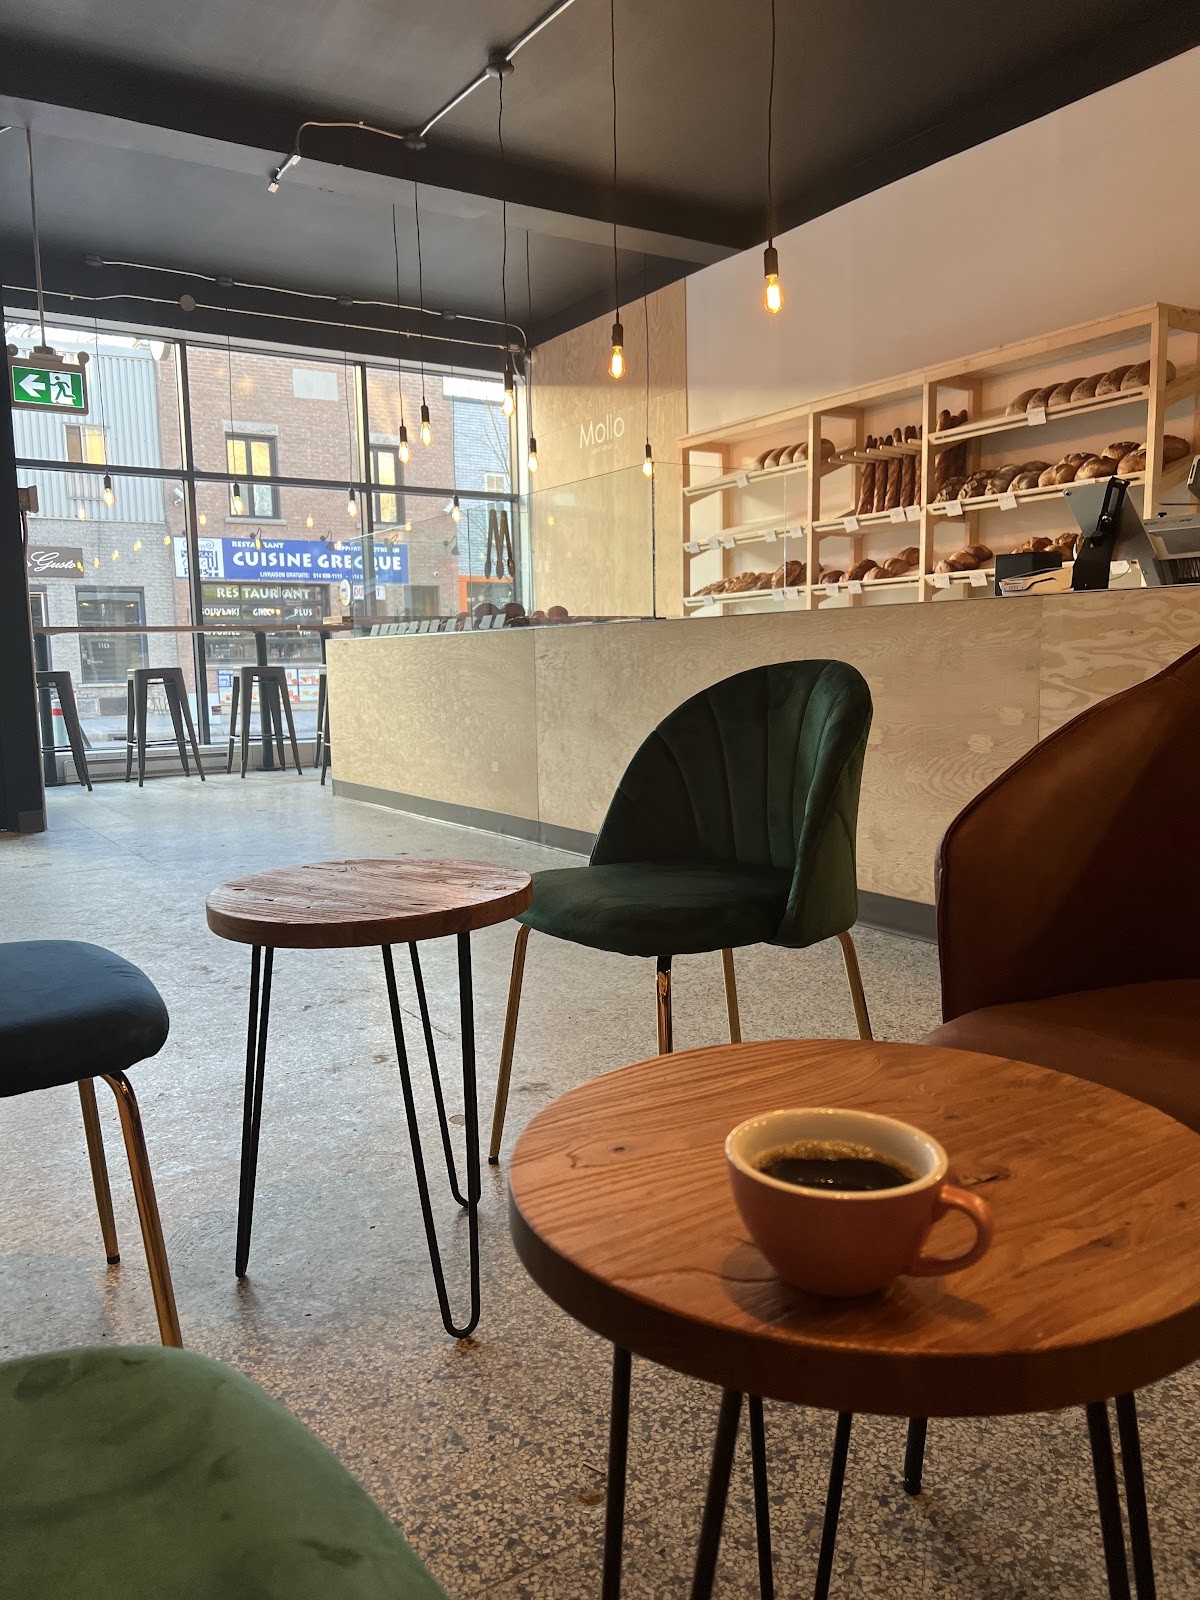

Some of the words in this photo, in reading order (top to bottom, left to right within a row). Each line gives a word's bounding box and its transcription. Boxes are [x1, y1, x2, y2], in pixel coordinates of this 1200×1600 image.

[579, 413, 625, 449] Mollo
[231, 540, 285, 549] RESTARANT
[30, 550, 77, 572] Gusto
[232, 551, 312, 568] CUISINE
[293, 608, 313, 617] PLUS
